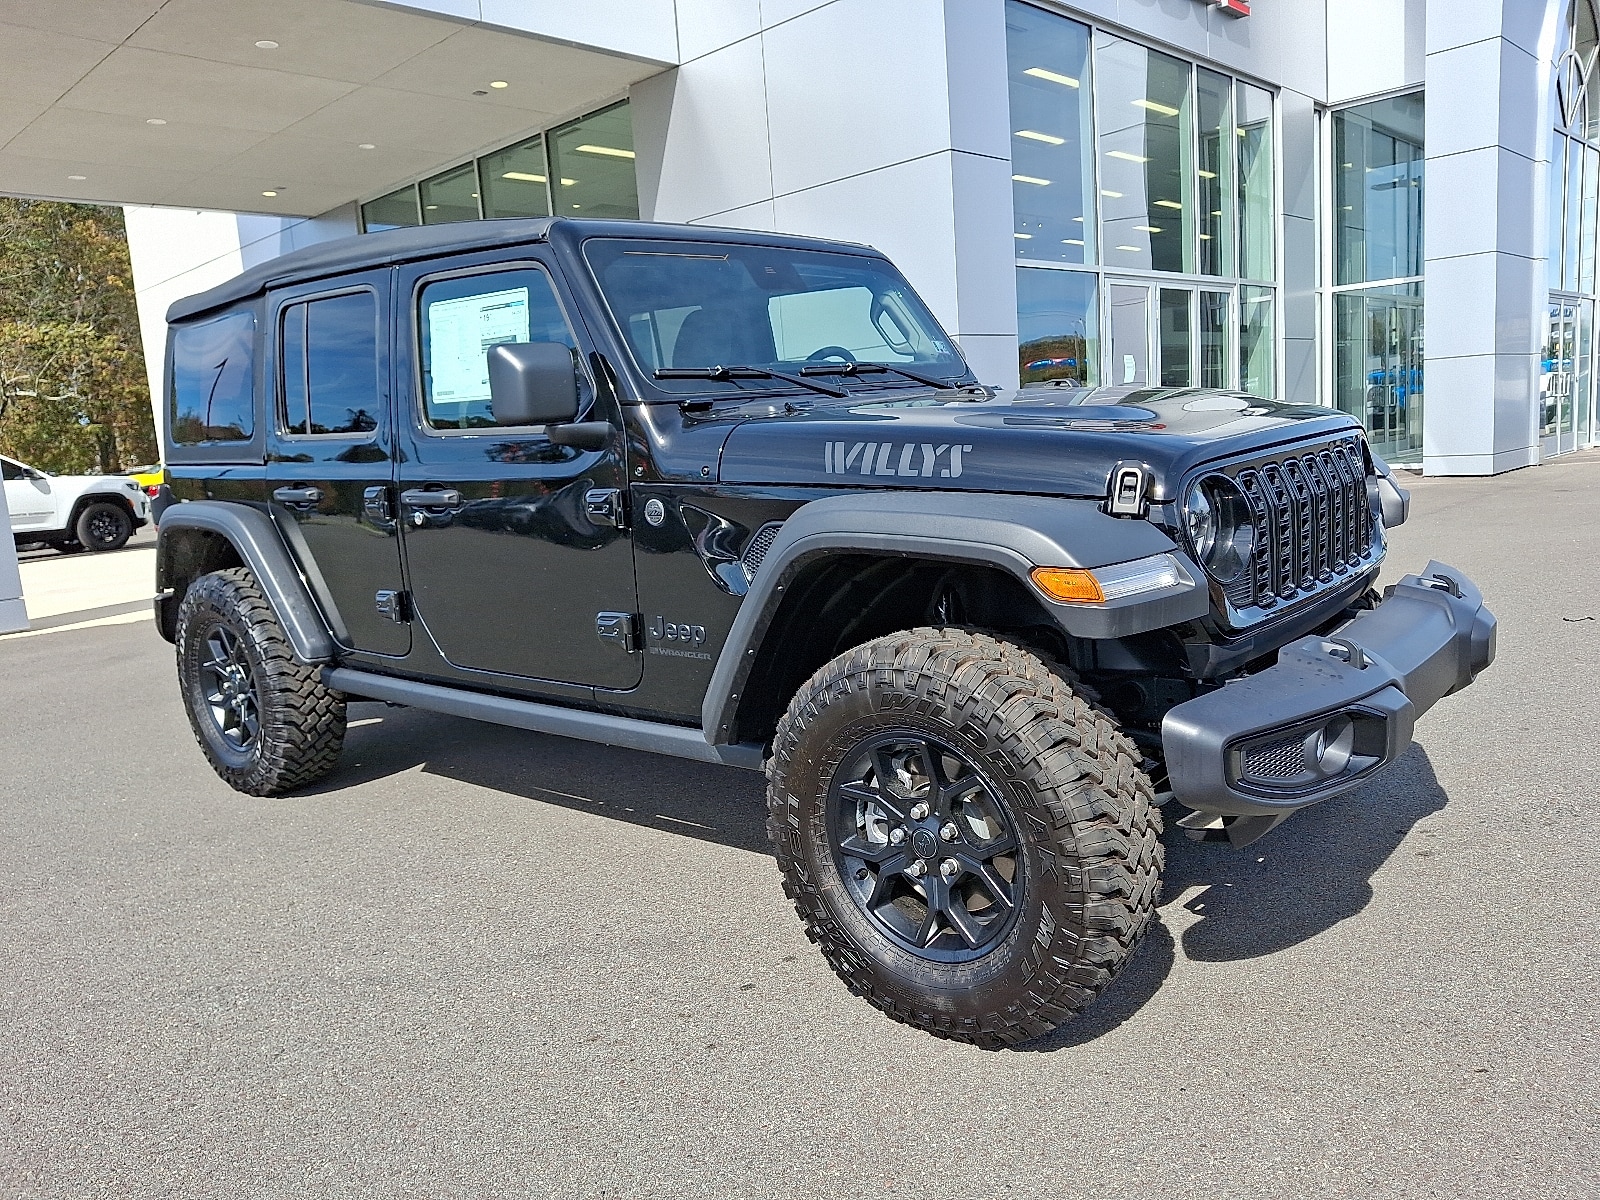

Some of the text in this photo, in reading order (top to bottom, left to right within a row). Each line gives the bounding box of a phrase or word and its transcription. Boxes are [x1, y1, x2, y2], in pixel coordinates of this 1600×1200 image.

[825, 441, 973, 478] WILLYS
[649, 615, 707, 649] Jeep
[659, 648, 712, 661] WRANGLER
